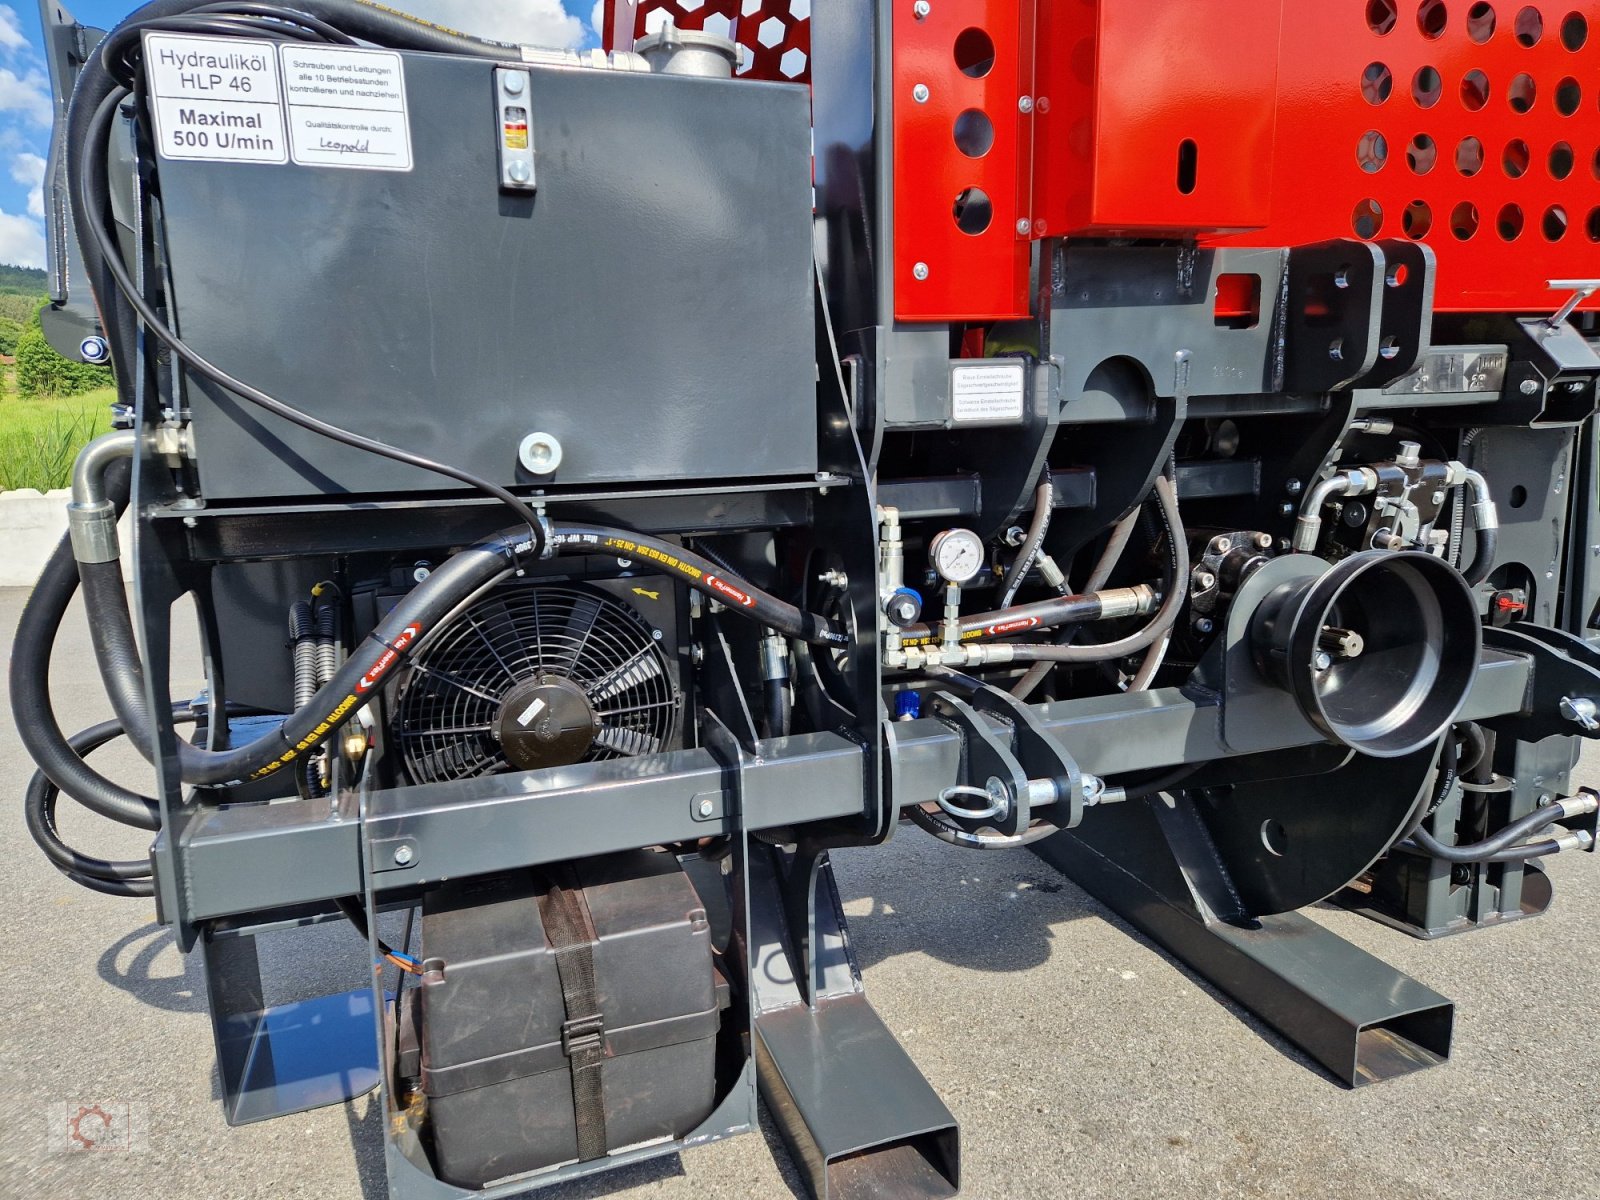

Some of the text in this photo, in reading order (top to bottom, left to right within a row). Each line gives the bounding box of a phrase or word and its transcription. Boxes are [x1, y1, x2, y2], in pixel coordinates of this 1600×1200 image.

[160, 48, 267, 72] Hydrauliköl
[293, 60, 391, 75] Schrauben und Leitungen
[180, 72, 252, 92] HLP 46
[316, 74, 324, 82] 10
[326, 76, 388, 86] Betriebsstunden
[290, 84, 400, 99] kontrollieren und nachziehen
[180, 108, 262, 128] Maximal
[305, 120, 392, 133] Qualitätskontrolle durch:
[174, 130, 274, 150] 500 U/min
[320, 136, 369, 154] Leopold
[568, 534, 579, 542] WP
[583, 534, 598, 543] Max
[637, 545, 649, 555] 2SN
[649, 550, 659, 558] 853
[659, 553, 667, 562] EN
[667, 558, 677, 567] DIN
[679, 563, 701, 577] SMOOTH
[715, 582, 743, 600] HammerFlex
[997, 620, 1029, 631] HammerFlex
[370, 637, 407, 677] HamerFlex
[327, 695, 358, 724] SMOOTH
[314, 722, 329, 735] DIN
[305, 732, 317, 744] EN
[296, 741, 307, 751] 85
[281, 749, 296, 764] 2SN
